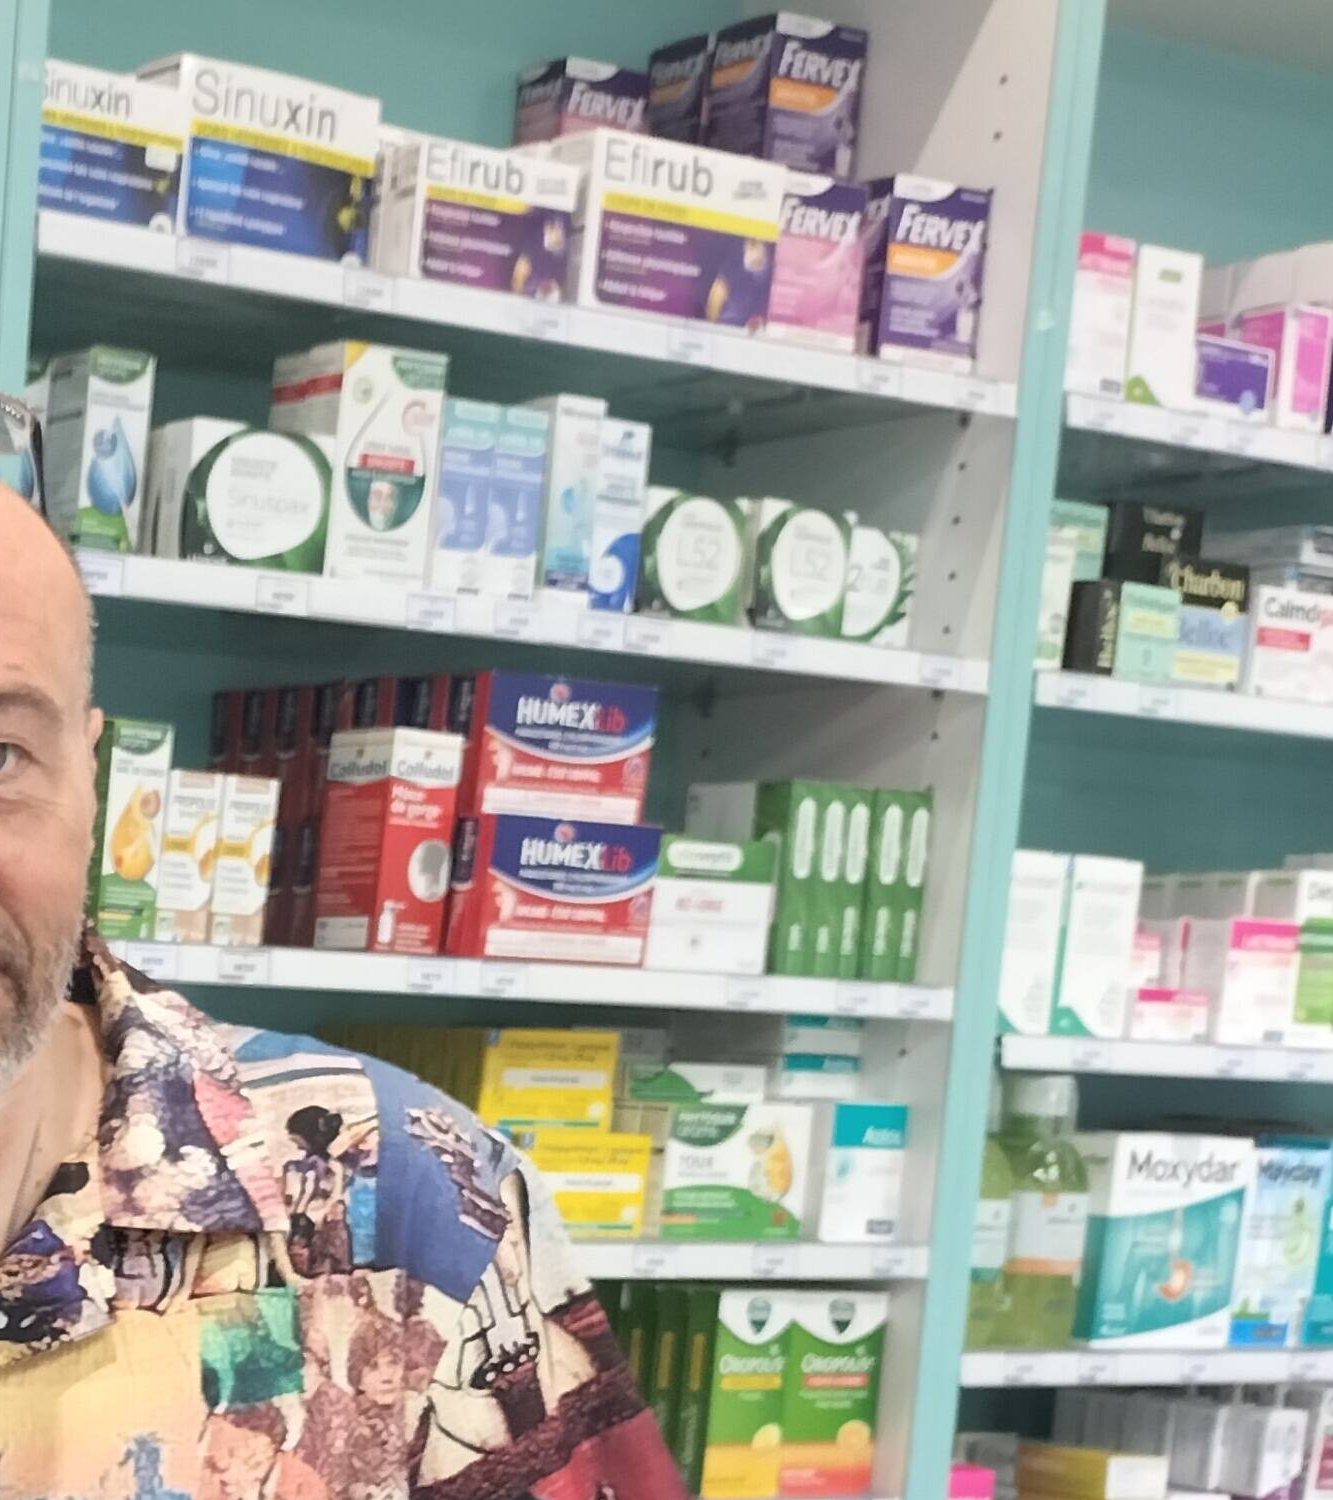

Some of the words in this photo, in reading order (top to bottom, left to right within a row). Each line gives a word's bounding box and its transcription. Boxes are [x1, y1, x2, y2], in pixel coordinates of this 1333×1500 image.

[779, 40, 861, 92] FERVEX
[193, 68, 336, 143] Sinuxin
[567, 81, 645, 127] FERVEX
[426, 142, 523, 195] Efirub
[604, 138, 713, 198] Efirub
[781, 197, 861, 242] FERVEX
[896, 203, 985, 252] FERVEX
[1126, 1150, 1239, 1188] Moxydar
